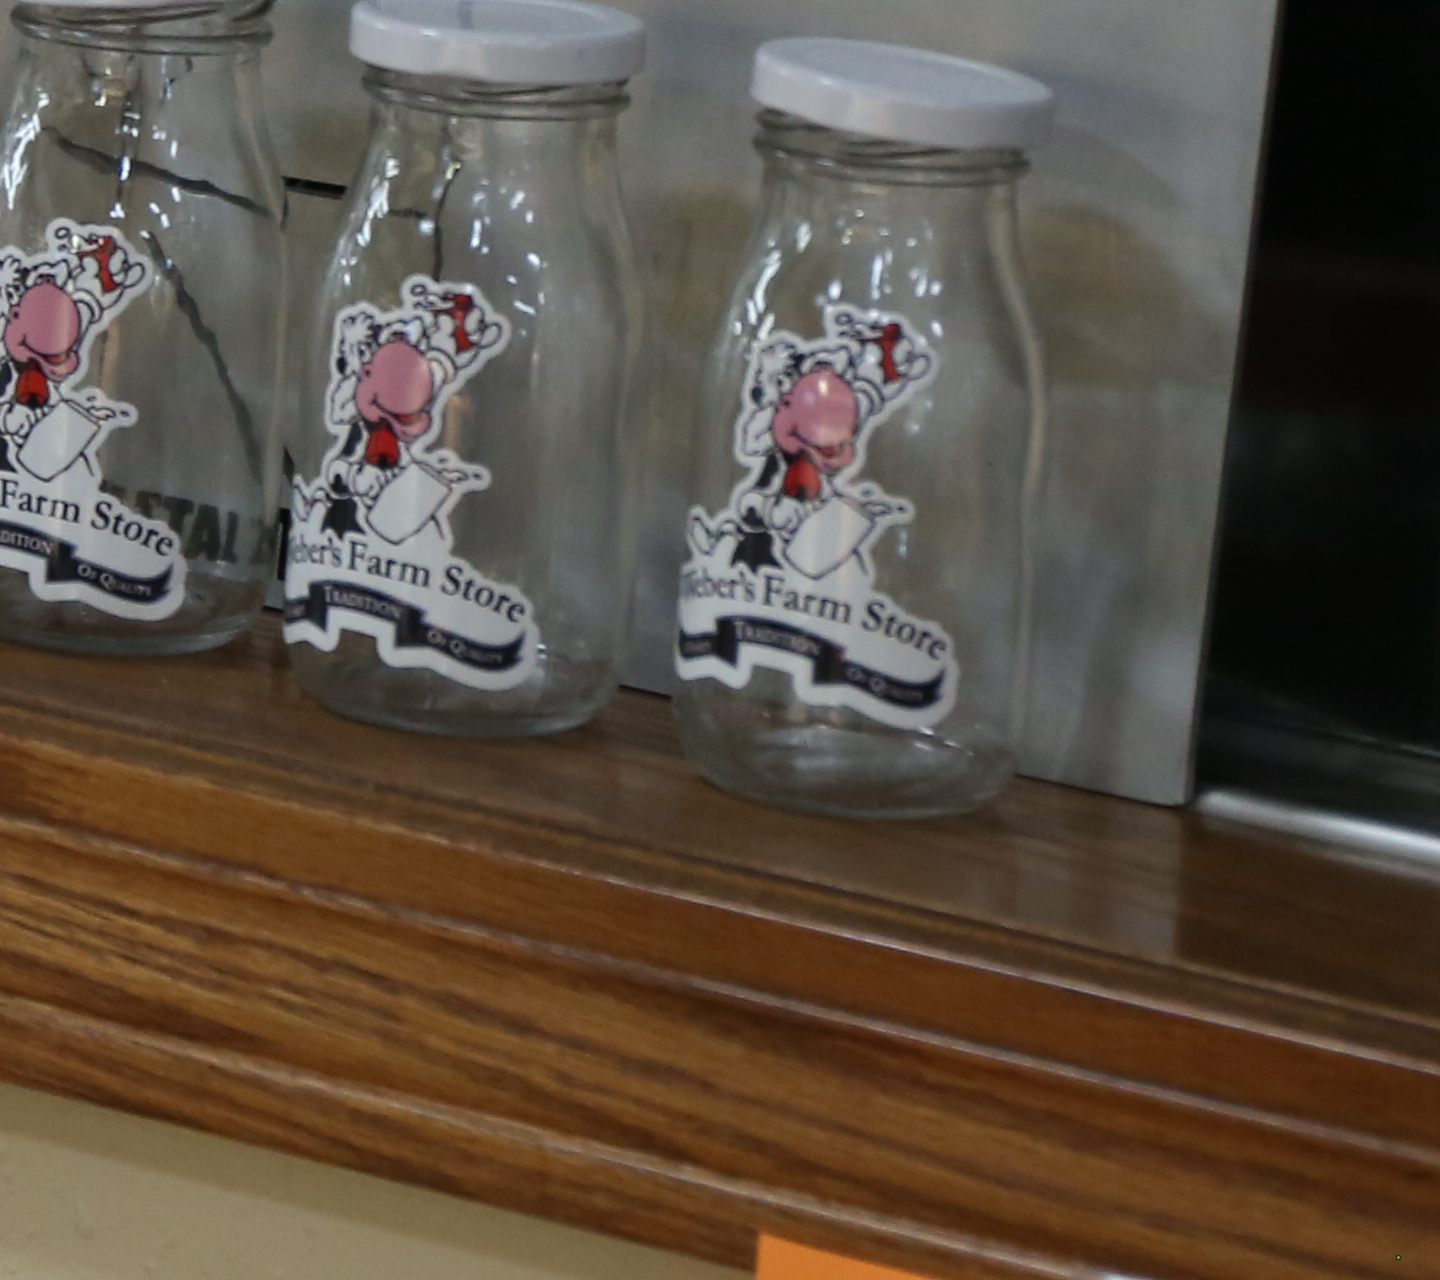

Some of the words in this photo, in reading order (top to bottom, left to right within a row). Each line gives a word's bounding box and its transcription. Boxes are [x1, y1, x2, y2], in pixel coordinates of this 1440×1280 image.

[91, 501, 173, 557] Store
[347, 540, 430, 588] Farm
[440, 565, 526, 623] Store
[763, 574, 850, 624] Farm
[861, 598, 946, 660] Store
